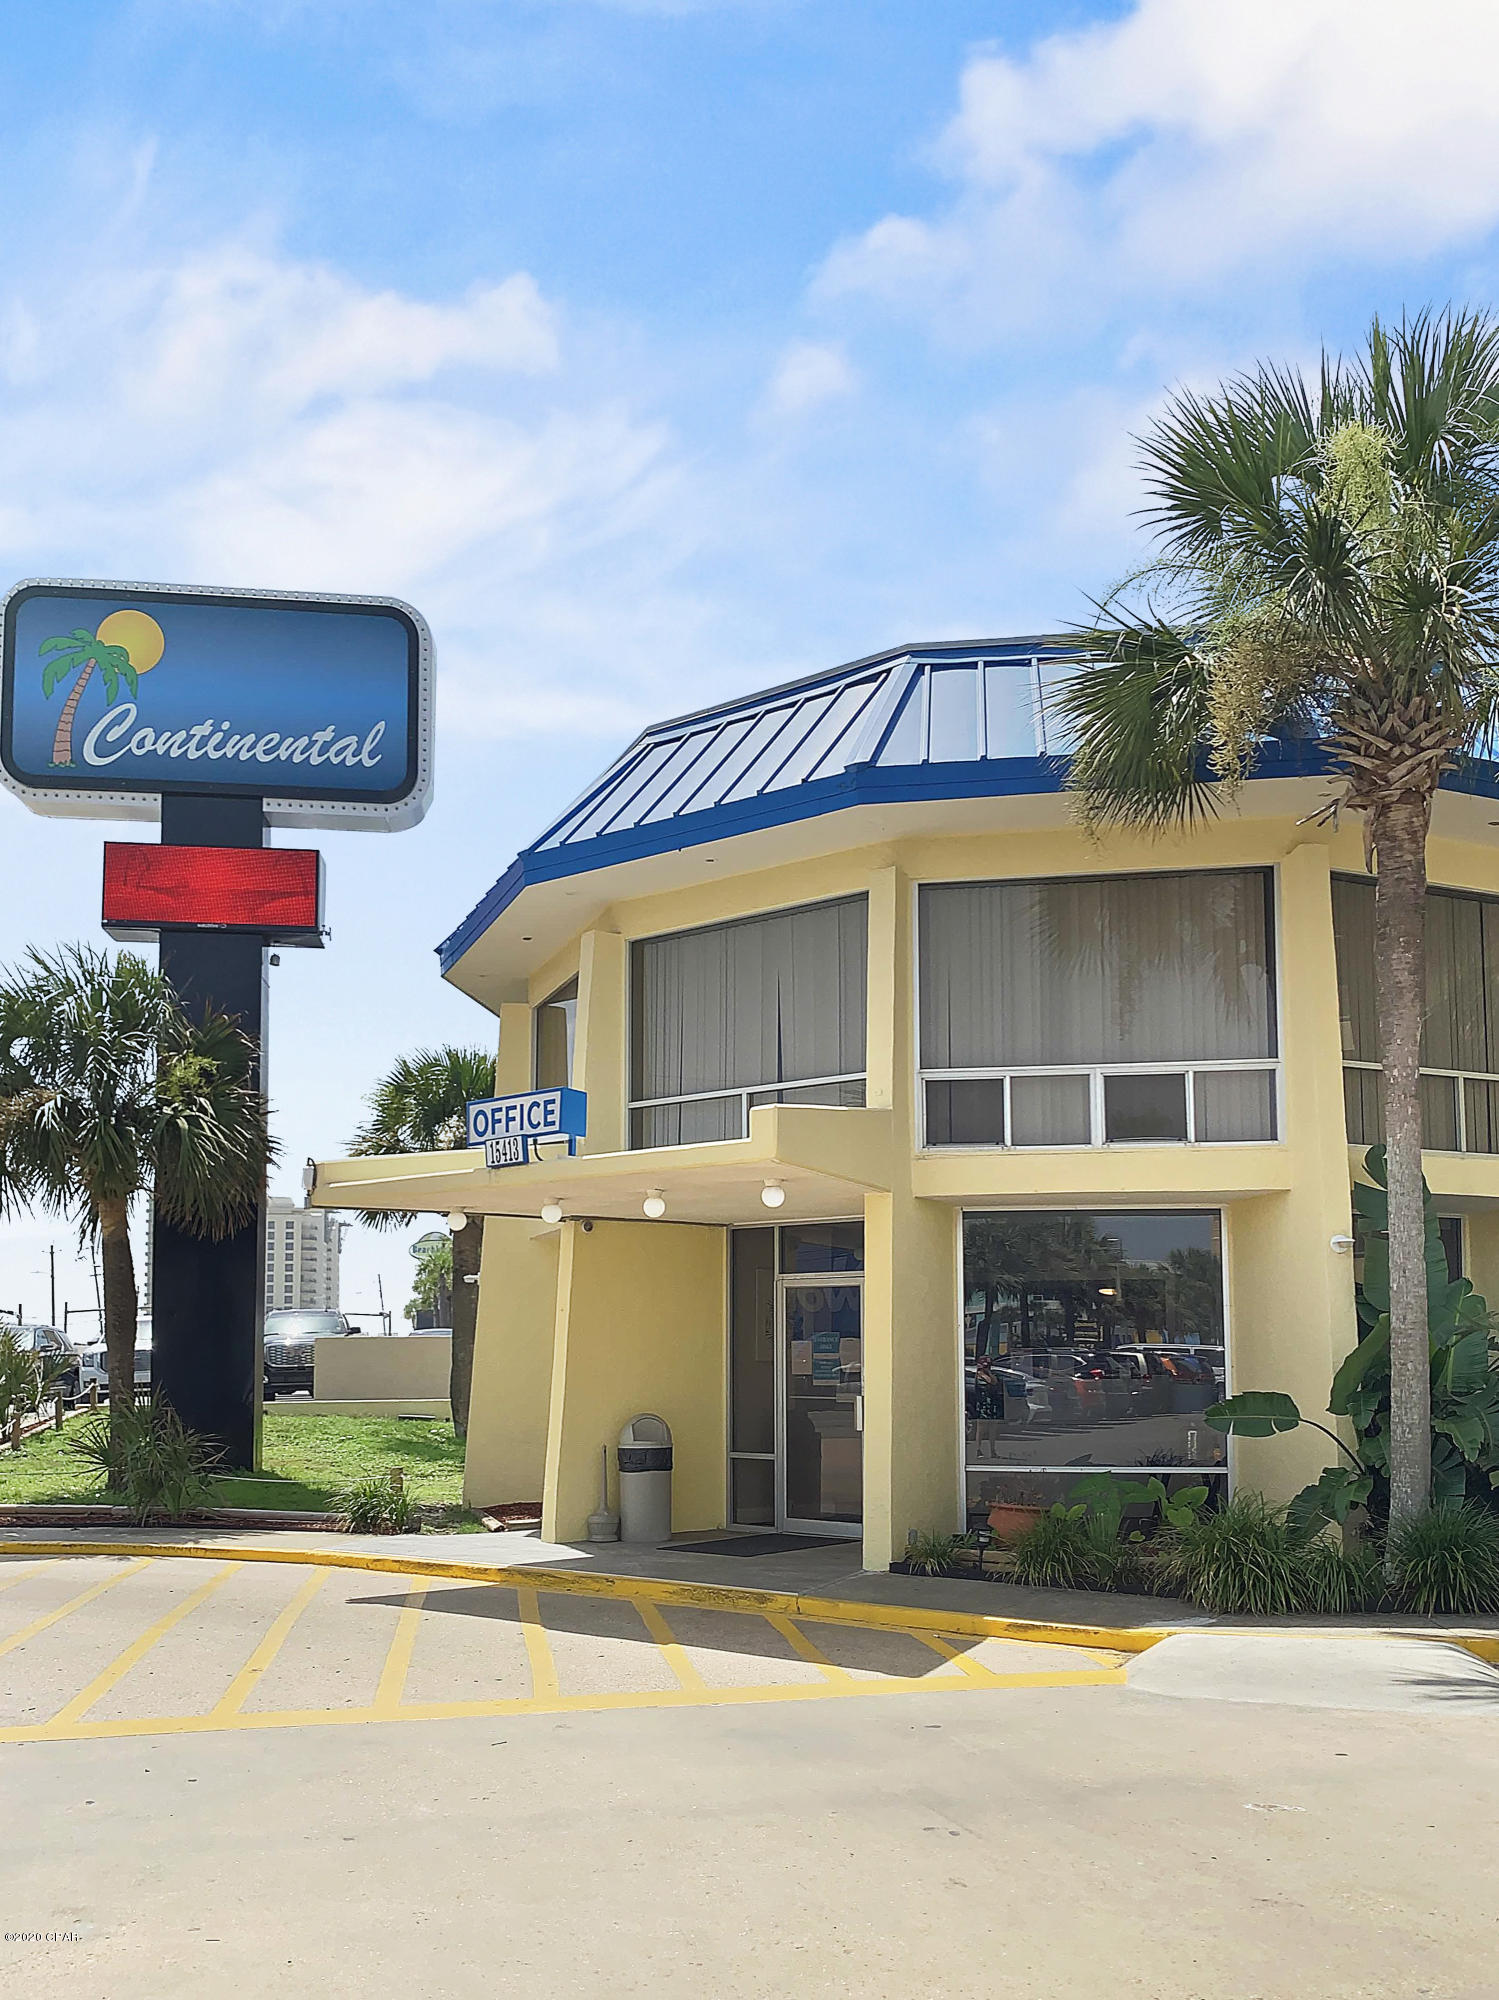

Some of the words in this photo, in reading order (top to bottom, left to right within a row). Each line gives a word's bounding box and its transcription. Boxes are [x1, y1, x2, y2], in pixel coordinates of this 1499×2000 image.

[83, 703, 386, 768] Continental
[473, 1099, 556, 1137] OFFICE
[489, 1138, 519, 1164] 15413
